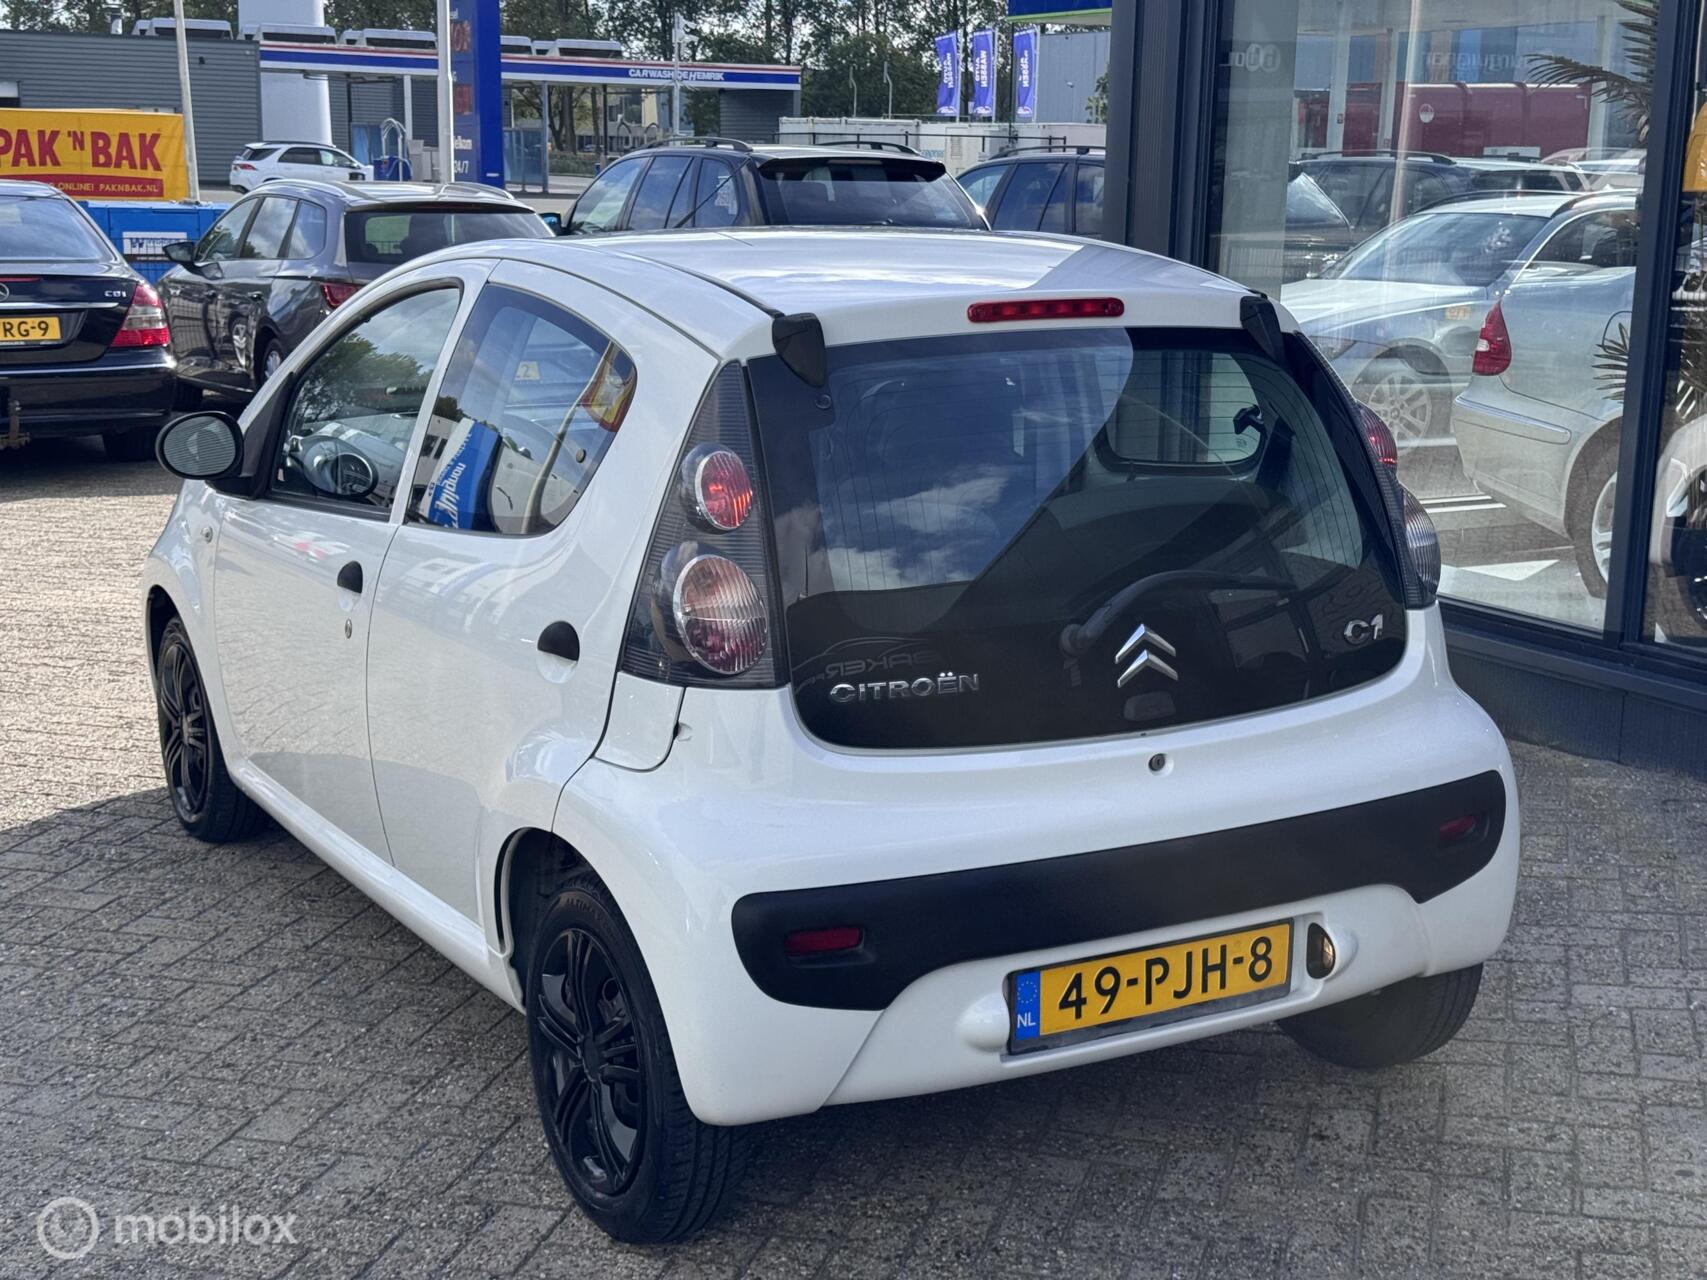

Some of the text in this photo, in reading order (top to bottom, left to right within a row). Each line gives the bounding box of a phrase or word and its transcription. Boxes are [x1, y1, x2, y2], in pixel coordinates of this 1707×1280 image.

[0, 128, 61, 167] PAK
[90, 131, 163, 171] BAK
[98, 183, 159, 192] PAKNBAK.NL
[104, 289, 128, 298] CDI
[1343, 613, 1384, 645] C1
[829, 671, 981, 703] CITROËN
[1016, 936, 1273, 1028] NL 49-PJH-8
